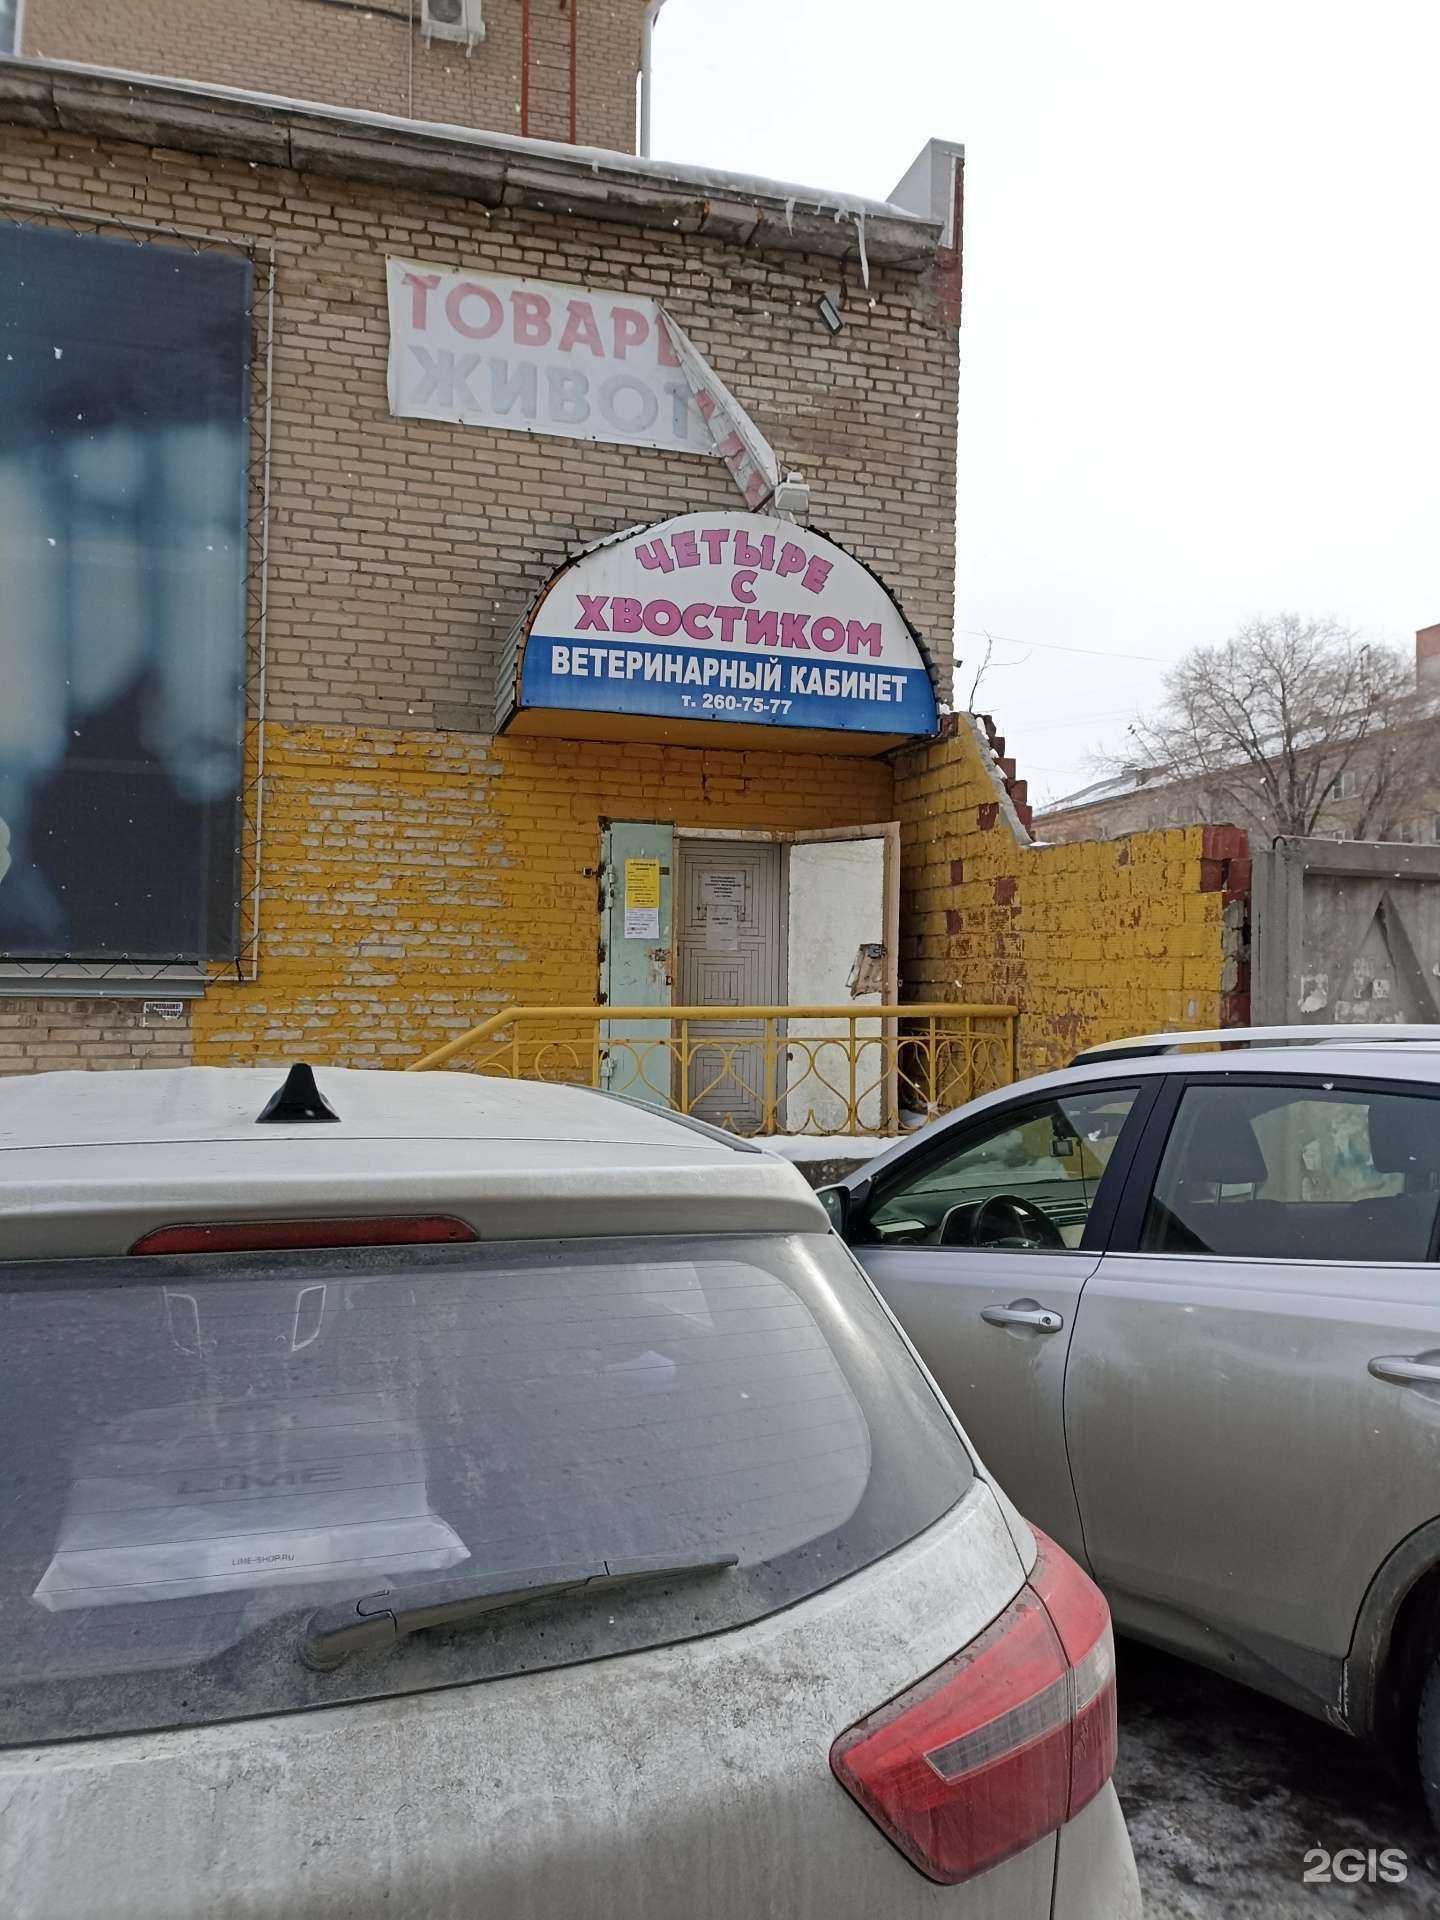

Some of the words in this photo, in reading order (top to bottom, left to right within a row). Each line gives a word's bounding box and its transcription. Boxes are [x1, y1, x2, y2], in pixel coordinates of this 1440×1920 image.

[634, 529, 835, 595] ЧЕТЫРЕ
[730, 569, 759, 604] С
[574, 594, 884, 658] ХВОСТИКОМ
[551, 645, 782, 694] ВЕТЕРИНАРНЫЙ
[790, 666, 908, 703] КАБИНЕТ
[702, 693, 793, 715] 260-75-77
